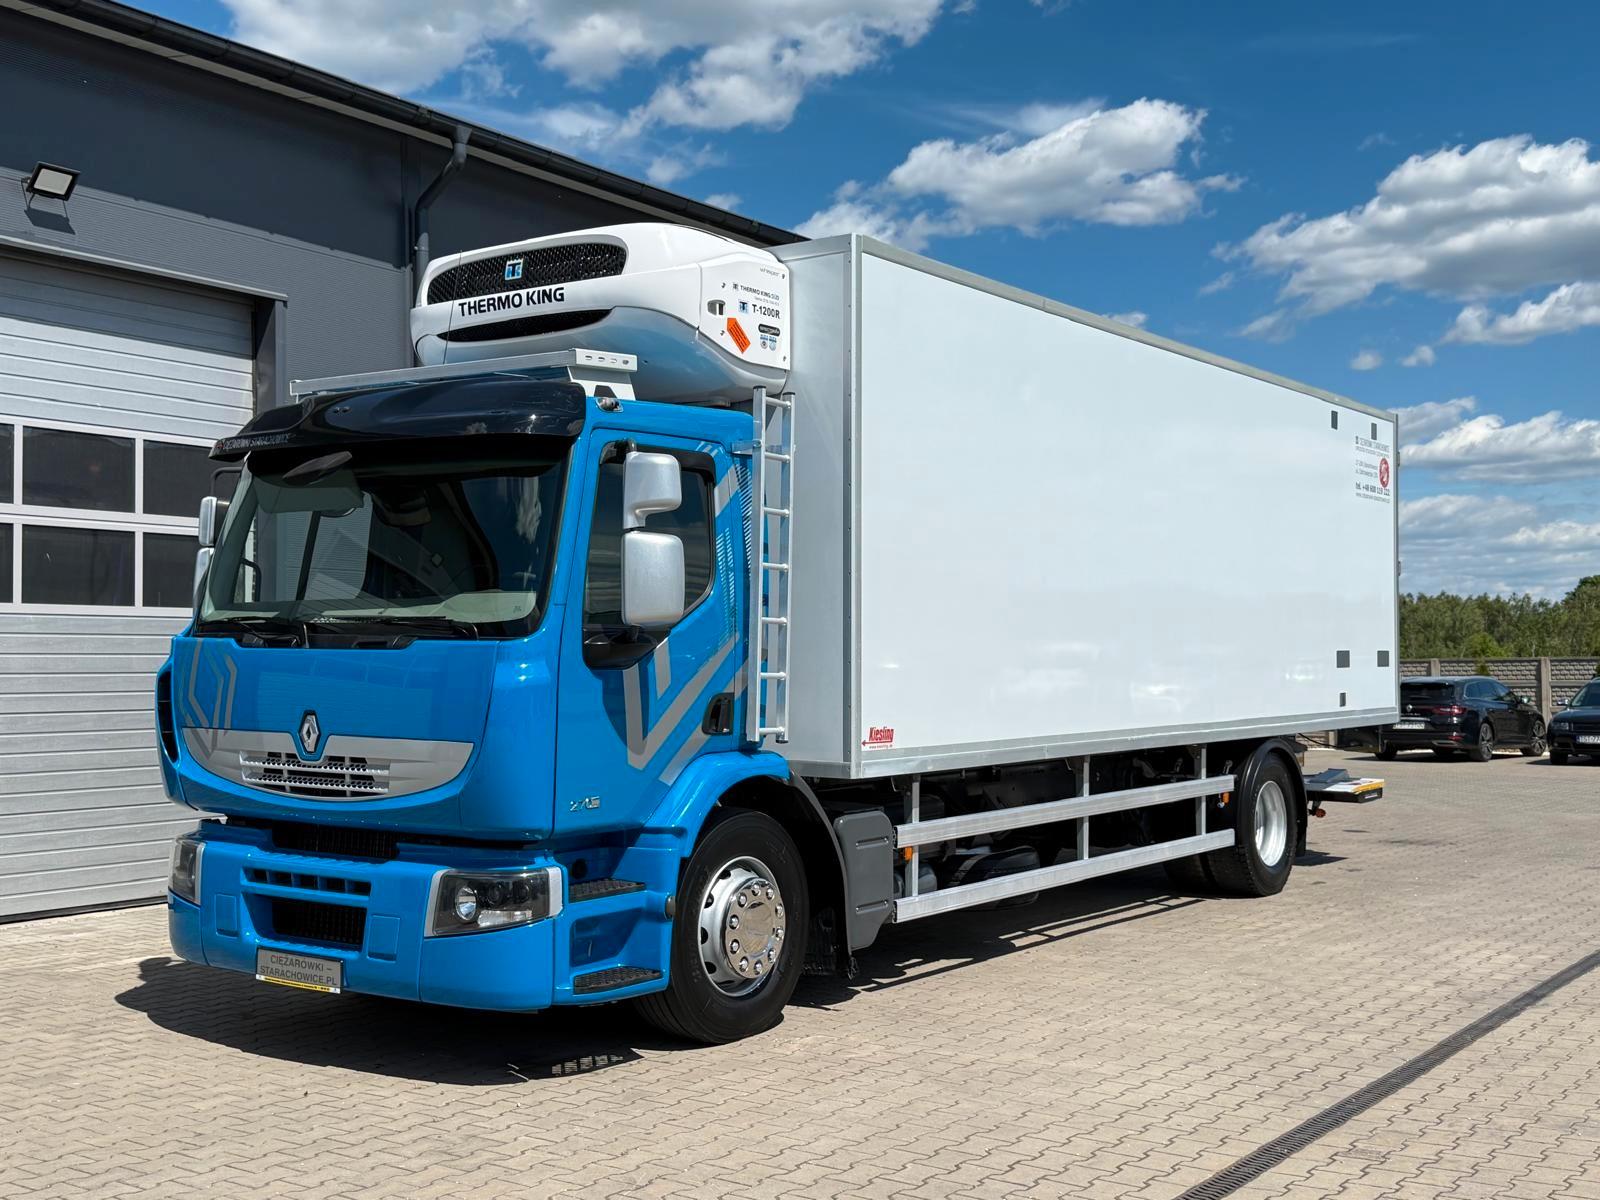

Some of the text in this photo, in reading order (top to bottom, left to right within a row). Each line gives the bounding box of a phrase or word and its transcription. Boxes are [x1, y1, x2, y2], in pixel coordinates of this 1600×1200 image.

[740, 284, 760, 296] THERMO
[760, 290, 771, 299] KING
[458, 287, 565, 317] THERMO KING
[751, 303, 780, 319] T-1200R
[869, 726, 894, 742] Kiesling
[260, 965, 337, 985] STARACHOWICE.PL
